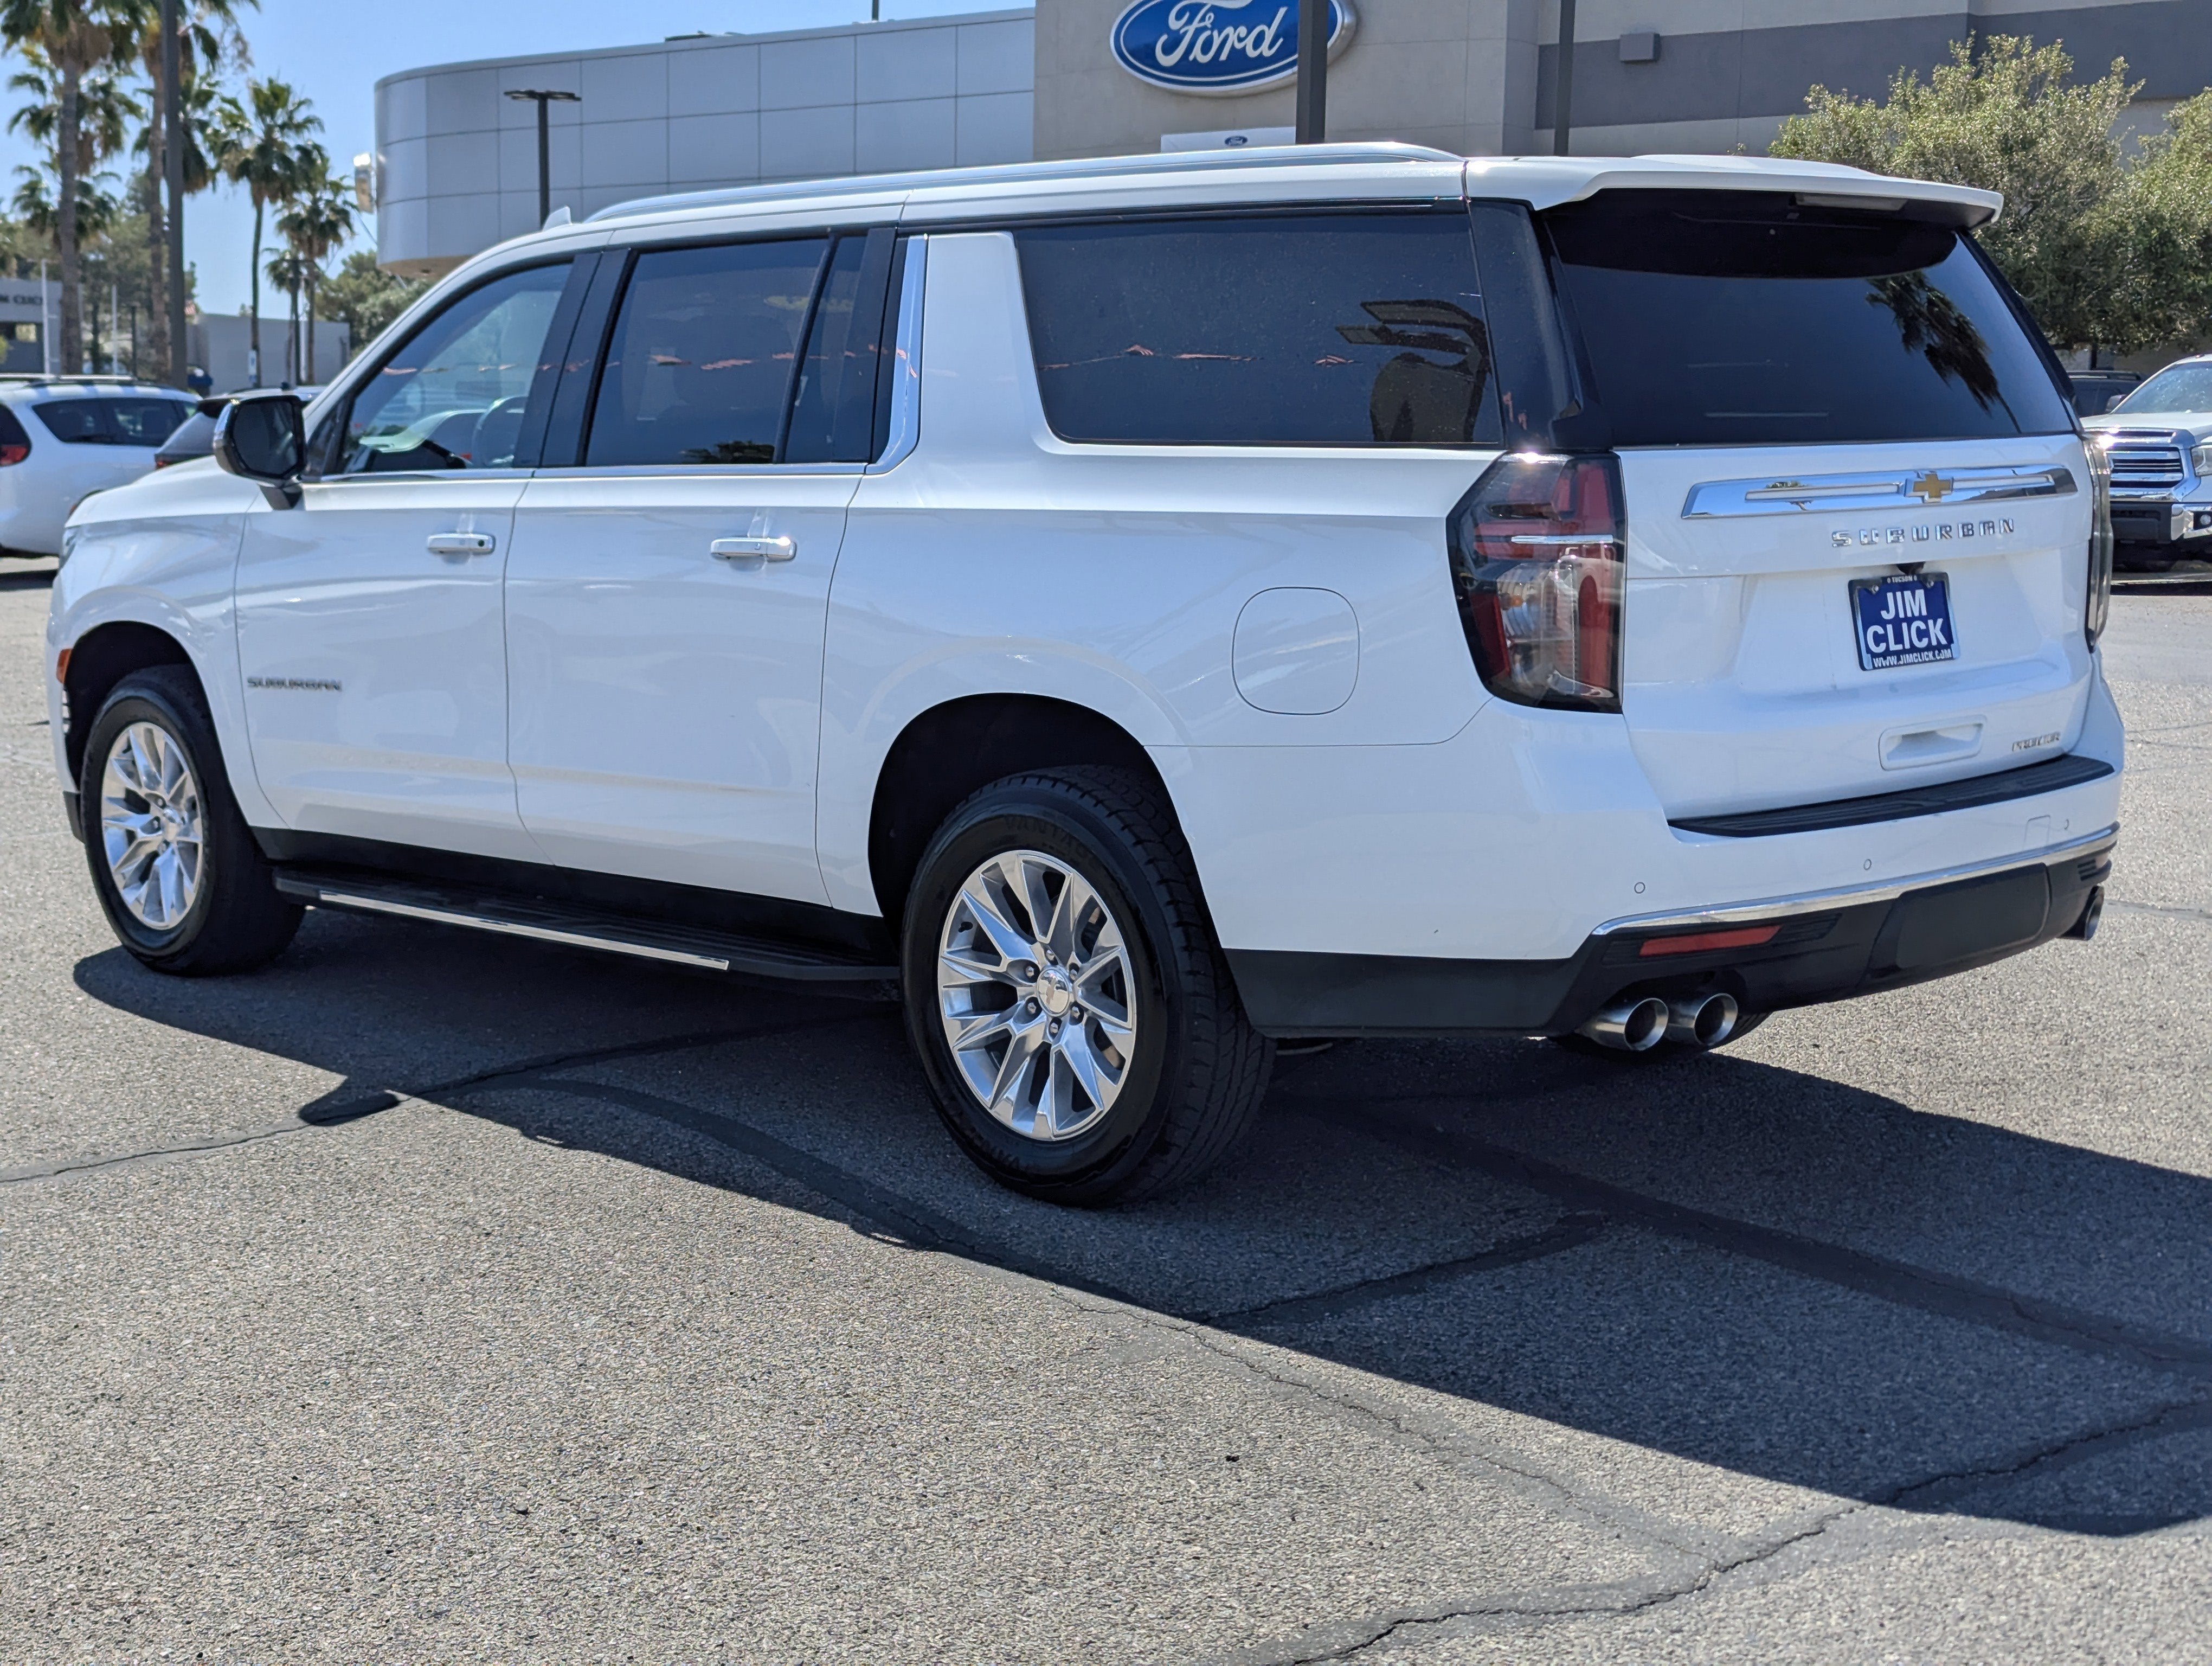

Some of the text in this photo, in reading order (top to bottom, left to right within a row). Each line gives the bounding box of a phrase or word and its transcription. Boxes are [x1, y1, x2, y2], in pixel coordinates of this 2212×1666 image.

[1155, 0, 1288, 67] Ford
[1831, 518, 2014, 547] SUBURBAN
[1880, 589, 1927, 620] JIM
[1867, 618, 1947, 653] CLICK
